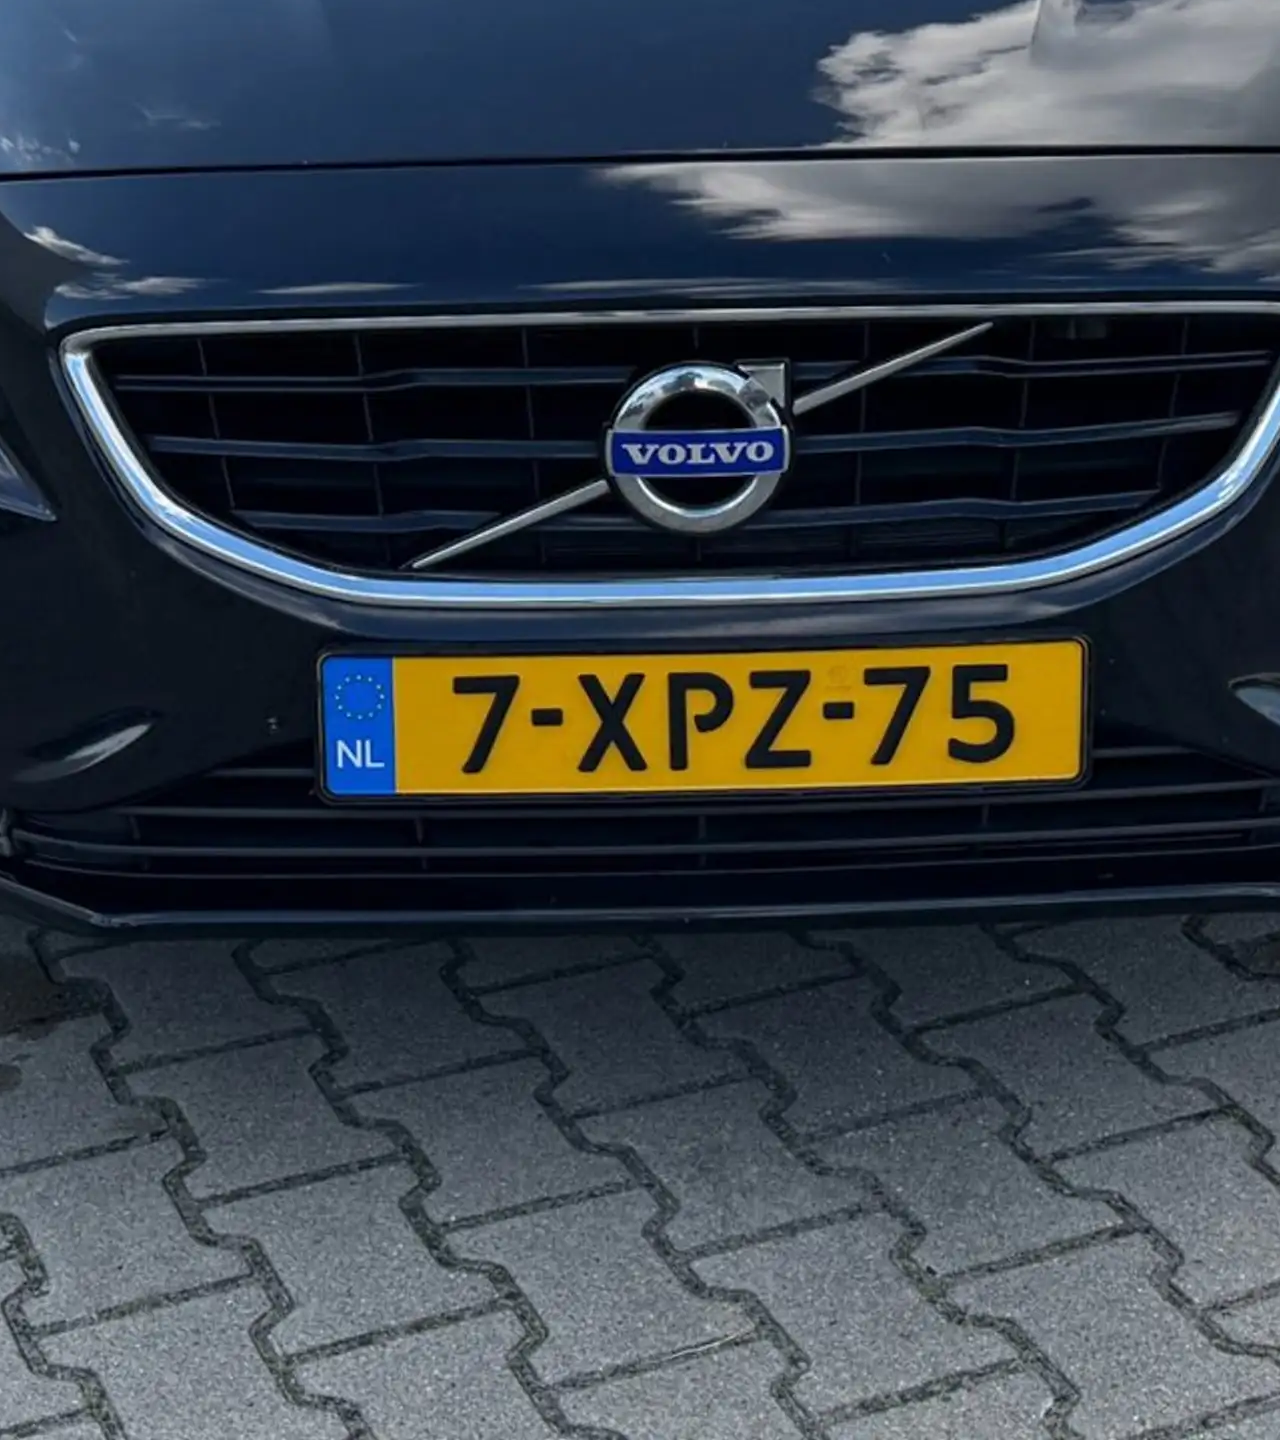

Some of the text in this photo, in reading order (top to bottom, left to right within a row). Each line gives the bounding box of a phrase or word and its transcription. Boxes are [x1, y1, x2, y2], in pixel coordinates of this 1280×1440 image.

[622, 441, 774, 465] VOLVO
[452, 664, 1015, 774] 7-XPZ-75
[336, 739, 384, 769] NL
